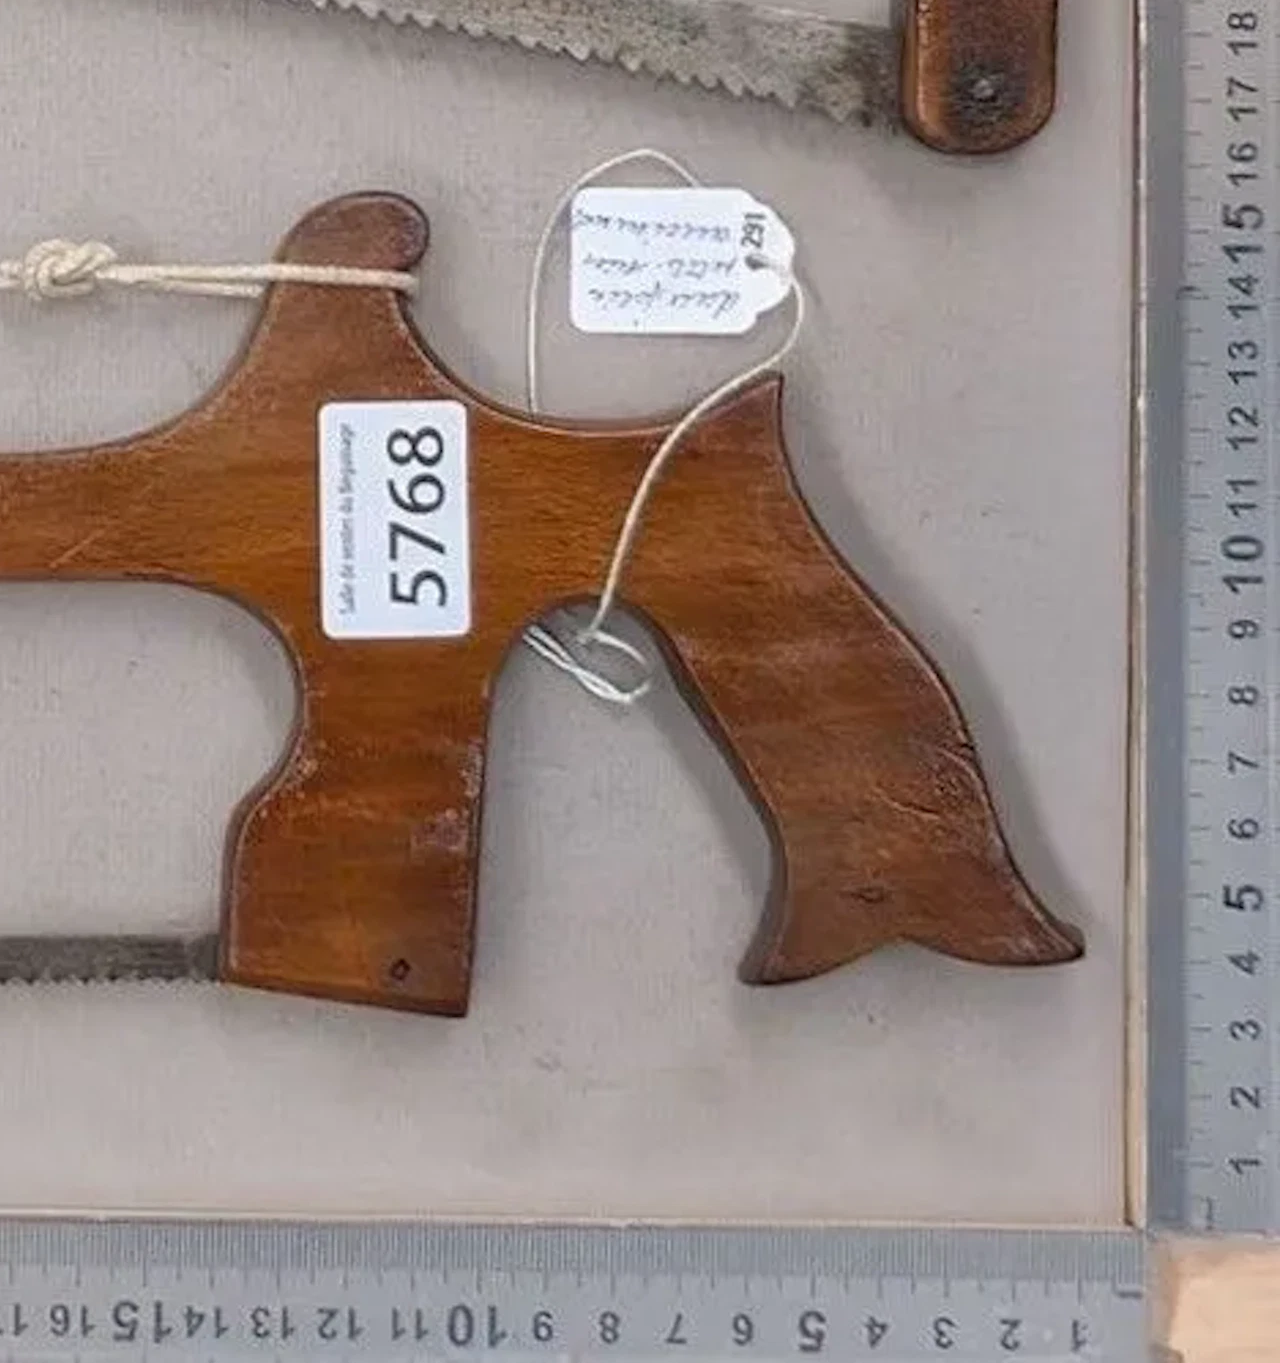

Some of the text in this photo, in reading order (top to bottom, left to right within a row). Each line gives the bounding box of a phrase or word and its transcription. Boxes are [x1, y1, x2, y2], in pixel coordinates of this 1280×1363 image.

[1226, 11, 1259, 57] 18
[1225, 76, 1259, 123] 17
[1226, 141, 1259, 188] 16
[1221, 203, 1265, 265] 15
[1226, 274, 1259, 320] 14
[1227, 339, 1259, 386] 13
[1225, 406, 1260, 452] 12
[1225, 479, 1259, 518] 11
[385, 425, 448, 609] 5768
[1220, 534, 1265, 595] 10
[1227, 619, 1260, 641] 9
[1226, 685, 1260, 708] 8
[1227, 750, 1260, 774] 7
[1226, 817, 1261, 841] 6
[1222, 884, 1265, 912] 5
[1227, 950, 1261, 976] 4
[1228, 1019, 1262, 1041] 3
[1229, 1086, 1261, 1110] 2
[1228, 1158, 1261, 1176] 1
[49, 1303, 96, 1338] 16
[111, 1300, 173, 1345] 15
[182, 1305, 229, 1339] 14
[250, 1306, 296, 1341] 13
[317, 1307, 364, 1341] 12
[391, 1307, 429, 1342] 11
[446, 1303, 508, 1349] 10
[531, 1310, 554, 1343] 9
[598, 1310, 621, 1345] 8
[665, 1313, 688, 1345] 7
[731, 1312, 754, 1347] 6
[797, 1310, 827, 1354] 5
[864, 1316, 889, 1349] 4
[933, 1316, 957, 1350] 3
[999, 1318, 1022, 1352] 2
[1071, 1319, 1087, 1353] 1
